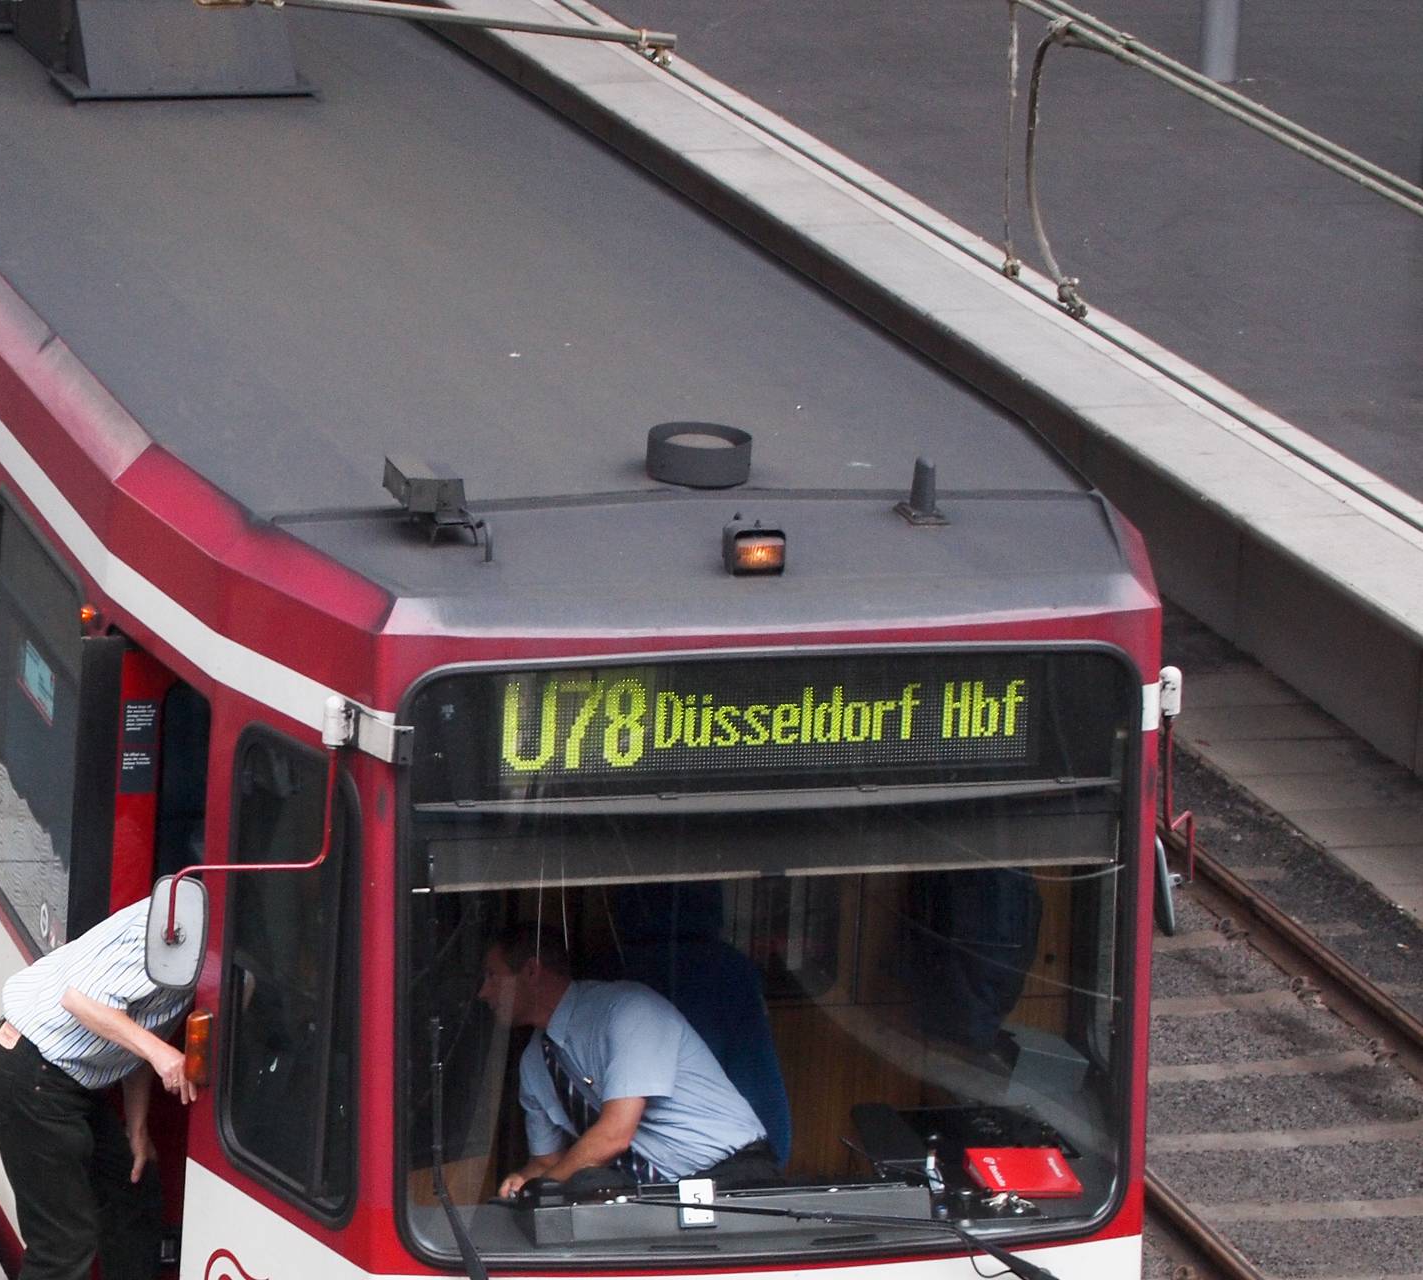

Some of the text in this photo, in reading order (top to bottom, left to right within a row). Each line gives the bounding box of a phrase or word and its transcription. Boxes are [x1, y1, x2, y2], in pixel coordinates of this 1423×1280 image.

[502, 679, 1024, 770] U78 Düsseldorf Hbf
